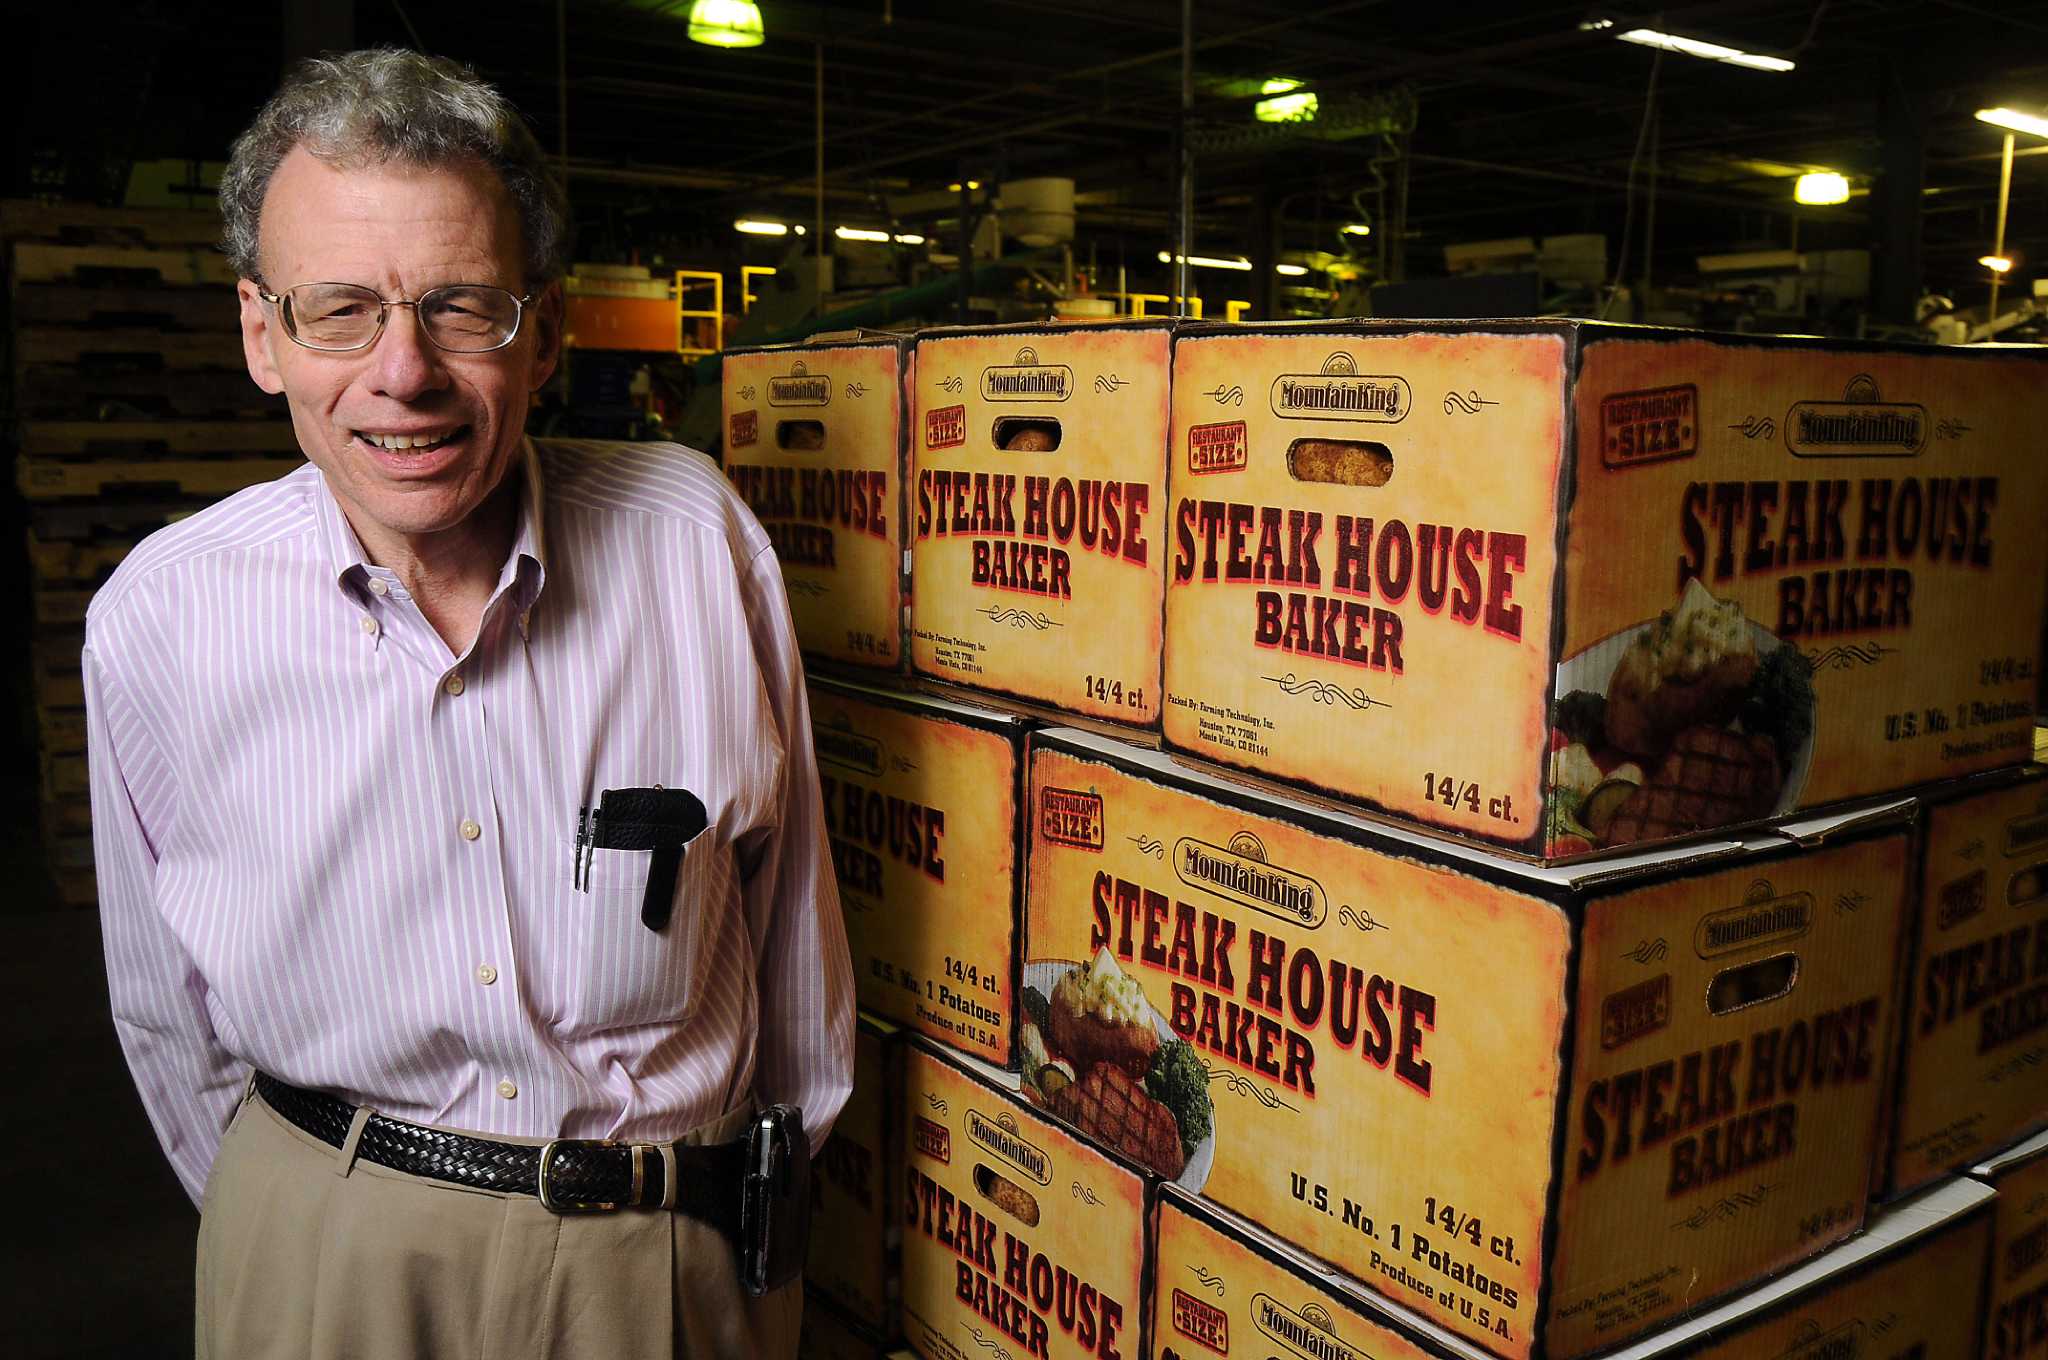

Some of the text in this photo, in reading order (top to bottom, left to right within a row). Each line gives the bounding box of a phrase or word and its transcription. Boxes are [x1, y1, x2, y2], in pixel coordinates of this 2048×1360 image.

[987, 369, 1067, 398] MountainKing
[1281, 380, 1400, 417] MountainKing
[932, 423, 959, 442] SIZE
[1192, 425, 1243, 447] RESTAURANT
[1199, 444, 1236, 466] SIZE
[1616, 419, 1680, 457] SIZE
[800, 467, 887, 541] HOUSE
[917, 468, 1149, 567] STEAK HOUSE
[1680, 476, 1999, 592] STEAK HOUSE
[971, 540, 1072, 600] BAKER
[1175, 497, 1527, 642] STEAK HOUSE
[1255, 591, 1404, 675] BAKER
[1778, 569, 1914, 639] BAKER
[1084, 673, 1148, 711] 14/4 ct.
[1167, 693, 1188, 707] Packed
[1200, 701, 1225, 718] Farming
[1226, 708, 1262, 728] Technology,
[1263, 717, 1276, 730] Inc.
[1199, 717, 1225, 734] Houston,
[1226, 725, 1236, 737] TX
[1199, 729, 1218, 743] Monte
[1219, 734, 1237, 750] Vista,
[1238, 740, 1247, 751] CO
[1052, 816, 1092, 841] SIZE
[1423, 773, 1520, 823] 14/4 ct.
[845, 782, 944, 884] HOUSE
[1184, 843, 1314, 923] MountainKing
[926, 979, 933, 1001] 1
[938, 984, 1001, 1027] Potatoes
[944, 956, 1001, 995] 14/4 ct.
[1091, 870, 1237, 995] STEAK
[1247, 929, 1437, 1098] HOUSE
[915, 1002, 1000, 1051] Produce of U.S.A.
[1170, 982, 1315, 1097] BAKER
[1578, 1040, 1743, 1183] STEAK
[1746, 1001, 1879, 1101] HOUSE
[1668, 1104, 1796, 1197] BAKER
[906, 1166, 998, 1280] STEAK
[1003, 1230, 1123, 1360] HOUSE
[1290, 1171, 1335, 1217] U.S.
[1342, 1198, 1380, 1240] No.
[1390, 1223, 1401, 1251] 1
[1411, 1232, 1519, 1310] Potatoes
[1424, 1197, 1522, 1267] 14/4 ct.
[956, 1260, 1050, 1360] BAKER
[1369, 1250, 1434, 1299] Produce
[1438, 1291, 1456, 1311] of
[1459, 1296, 1515, 1342] U.S.A.
[1182, 1314, 1219, 1345] SIZE
